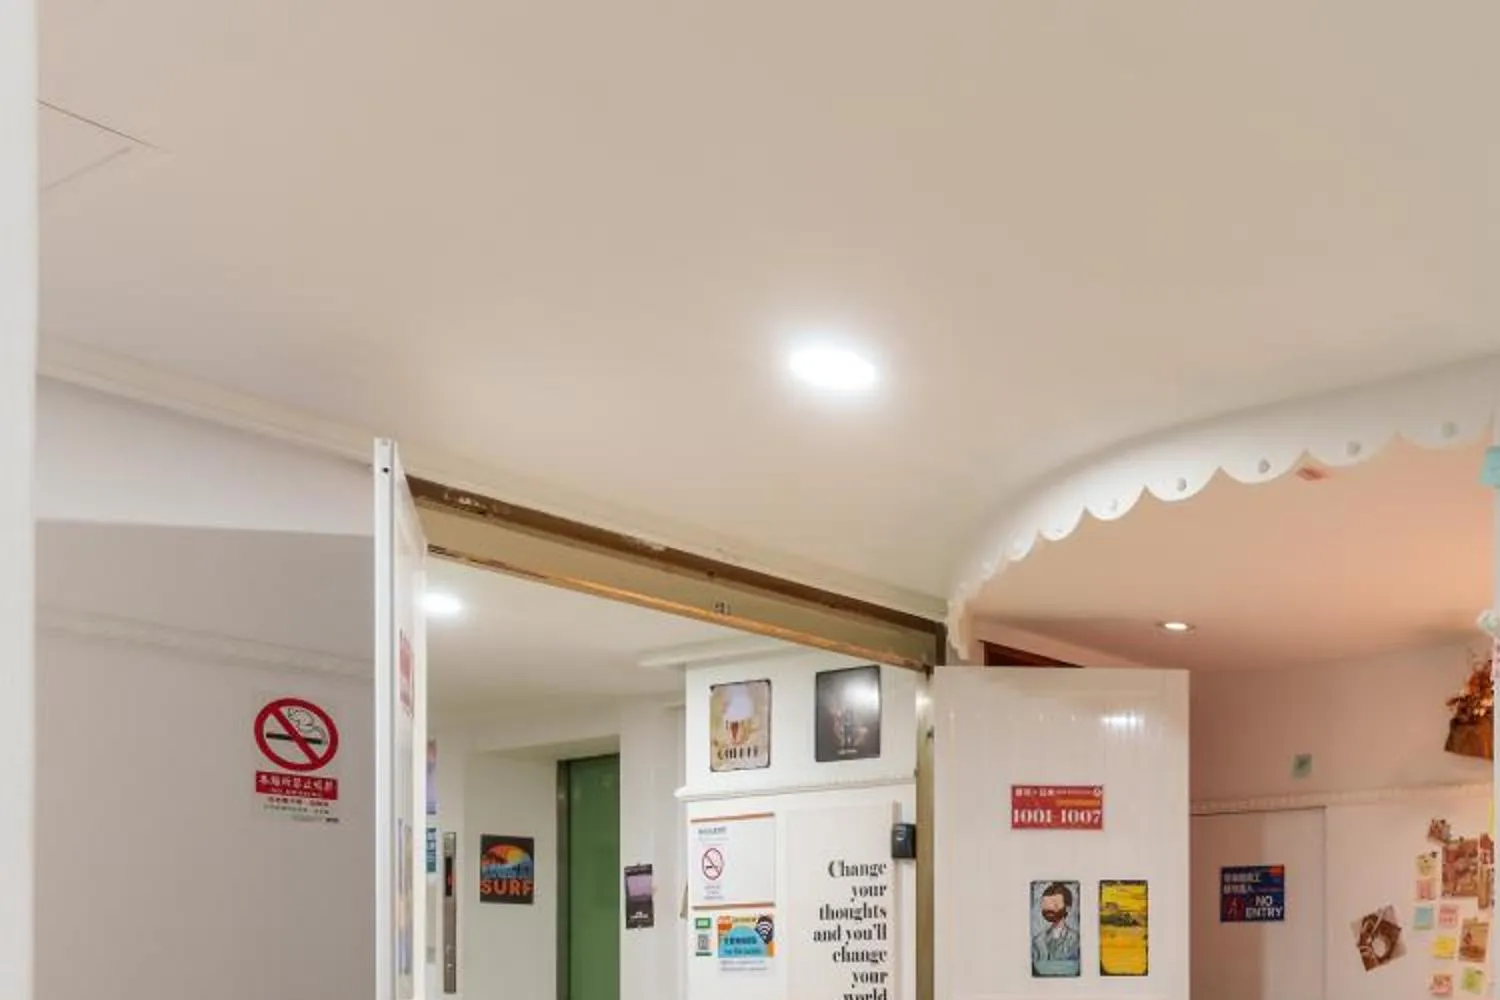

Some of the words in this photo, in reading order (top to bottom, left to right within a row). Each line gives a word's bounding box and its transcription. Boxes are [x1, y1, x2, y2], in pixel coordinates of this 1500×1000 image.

[1013, 808, 1101, 824] 1001-1007
[828, 860, 887, 878] Change
[480, 879, 533, 896] SURF
[851, 885, 887, 902] your
[1255, 895, 1273, 907] NO
[819, 902, 887, 920] thoughts
[1245, 906, 1283, 919] ENTRY
[813, 924, 841, 942] and
[845, 923, 887, 945] you'll
[832, 946, 888, 963] change
[851, 971, 888, 989] your
